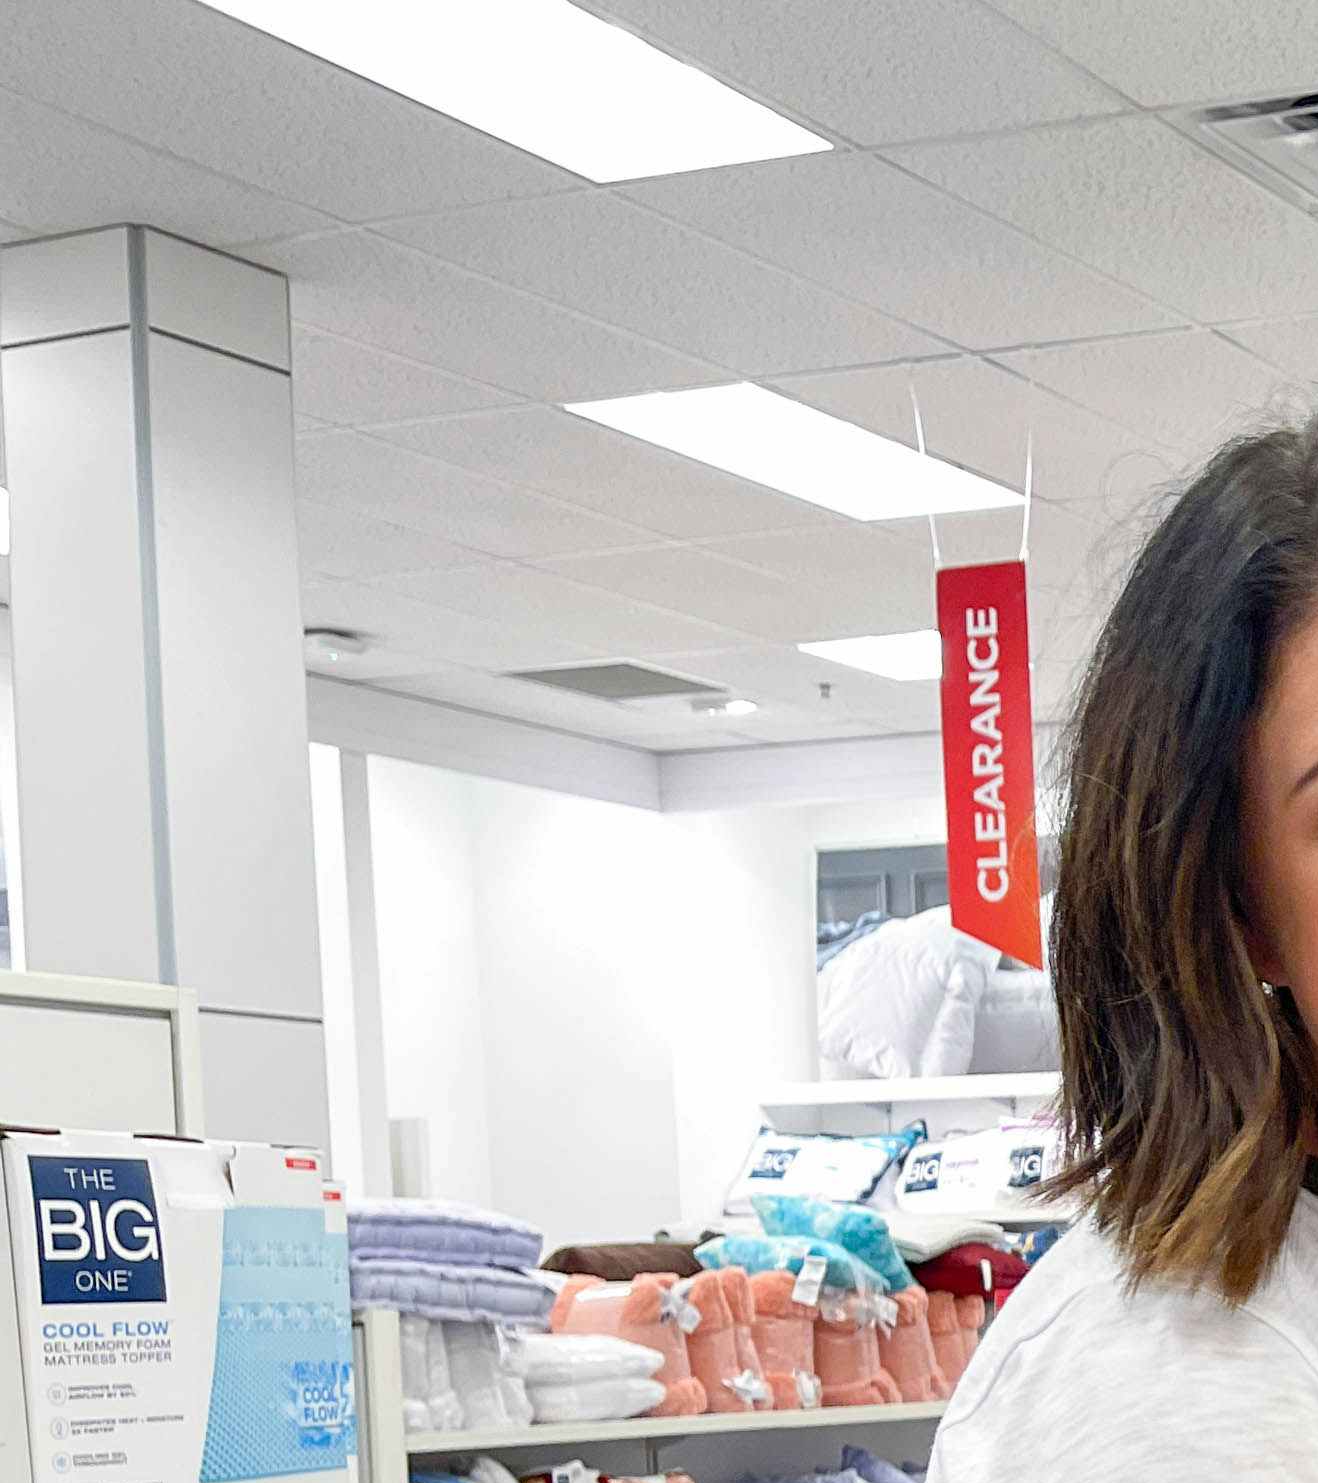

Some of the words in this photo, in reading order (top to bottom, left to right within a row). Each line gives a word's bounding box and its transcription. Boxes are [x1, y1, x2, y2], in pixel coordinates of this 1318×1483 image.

[963, 605, 1010, 903] CLEARANCE
[63, 1167, 116, 1191] THE
[39, 1199, 160, 1262] BIG
[75, 1270, 130, 1292] ONE
[43, 1323, 104, 1339] COOL
[112, 1320, 169, 1337] FLOW
[44, 1341, 70, 1353] GEL
[74, 1339, 132, 1353] MEMORY
[136, 1338, 171, 1350] FOAM
[44, 1352, 117, 1367] MATTRESS
[121, 1351, 172, 1364] TOPPER
[303, 1386, 339, 1404] COOL
[304, 1405, 340, 1423] FLOW
